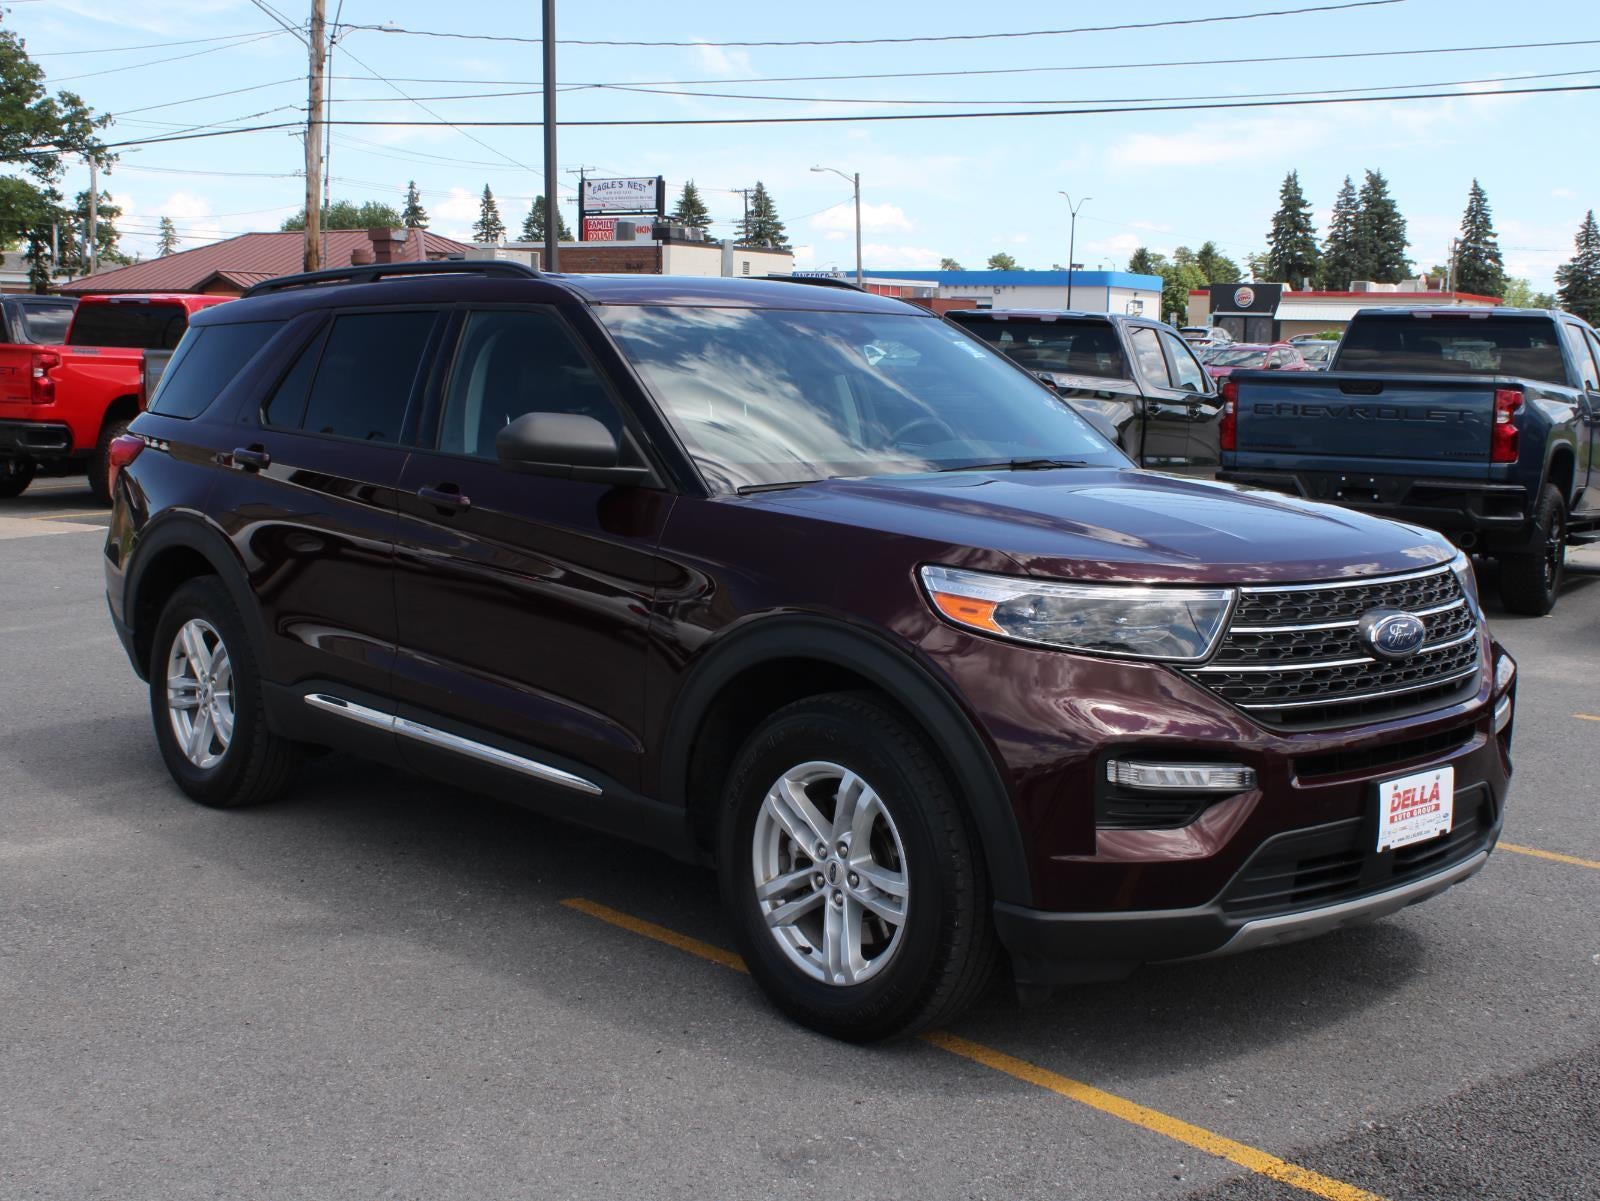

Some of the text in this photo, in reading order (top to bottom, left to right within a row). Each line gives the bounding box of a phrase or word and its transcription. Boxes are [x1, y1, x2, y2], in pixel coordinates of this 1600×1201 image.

[592, 181, 624, 194] EAGLE'S
[627, 181, 647, 192] NEST
[588, 220, 613, 230] FAMILY
[1254, 402, 1474, 424] CHEVROLET
[1388, 622, 1417, 646] Ford
[1390, 782, 1440, 813] DELLA
[1394, 805, 1436, 823] AUTO GROUP
